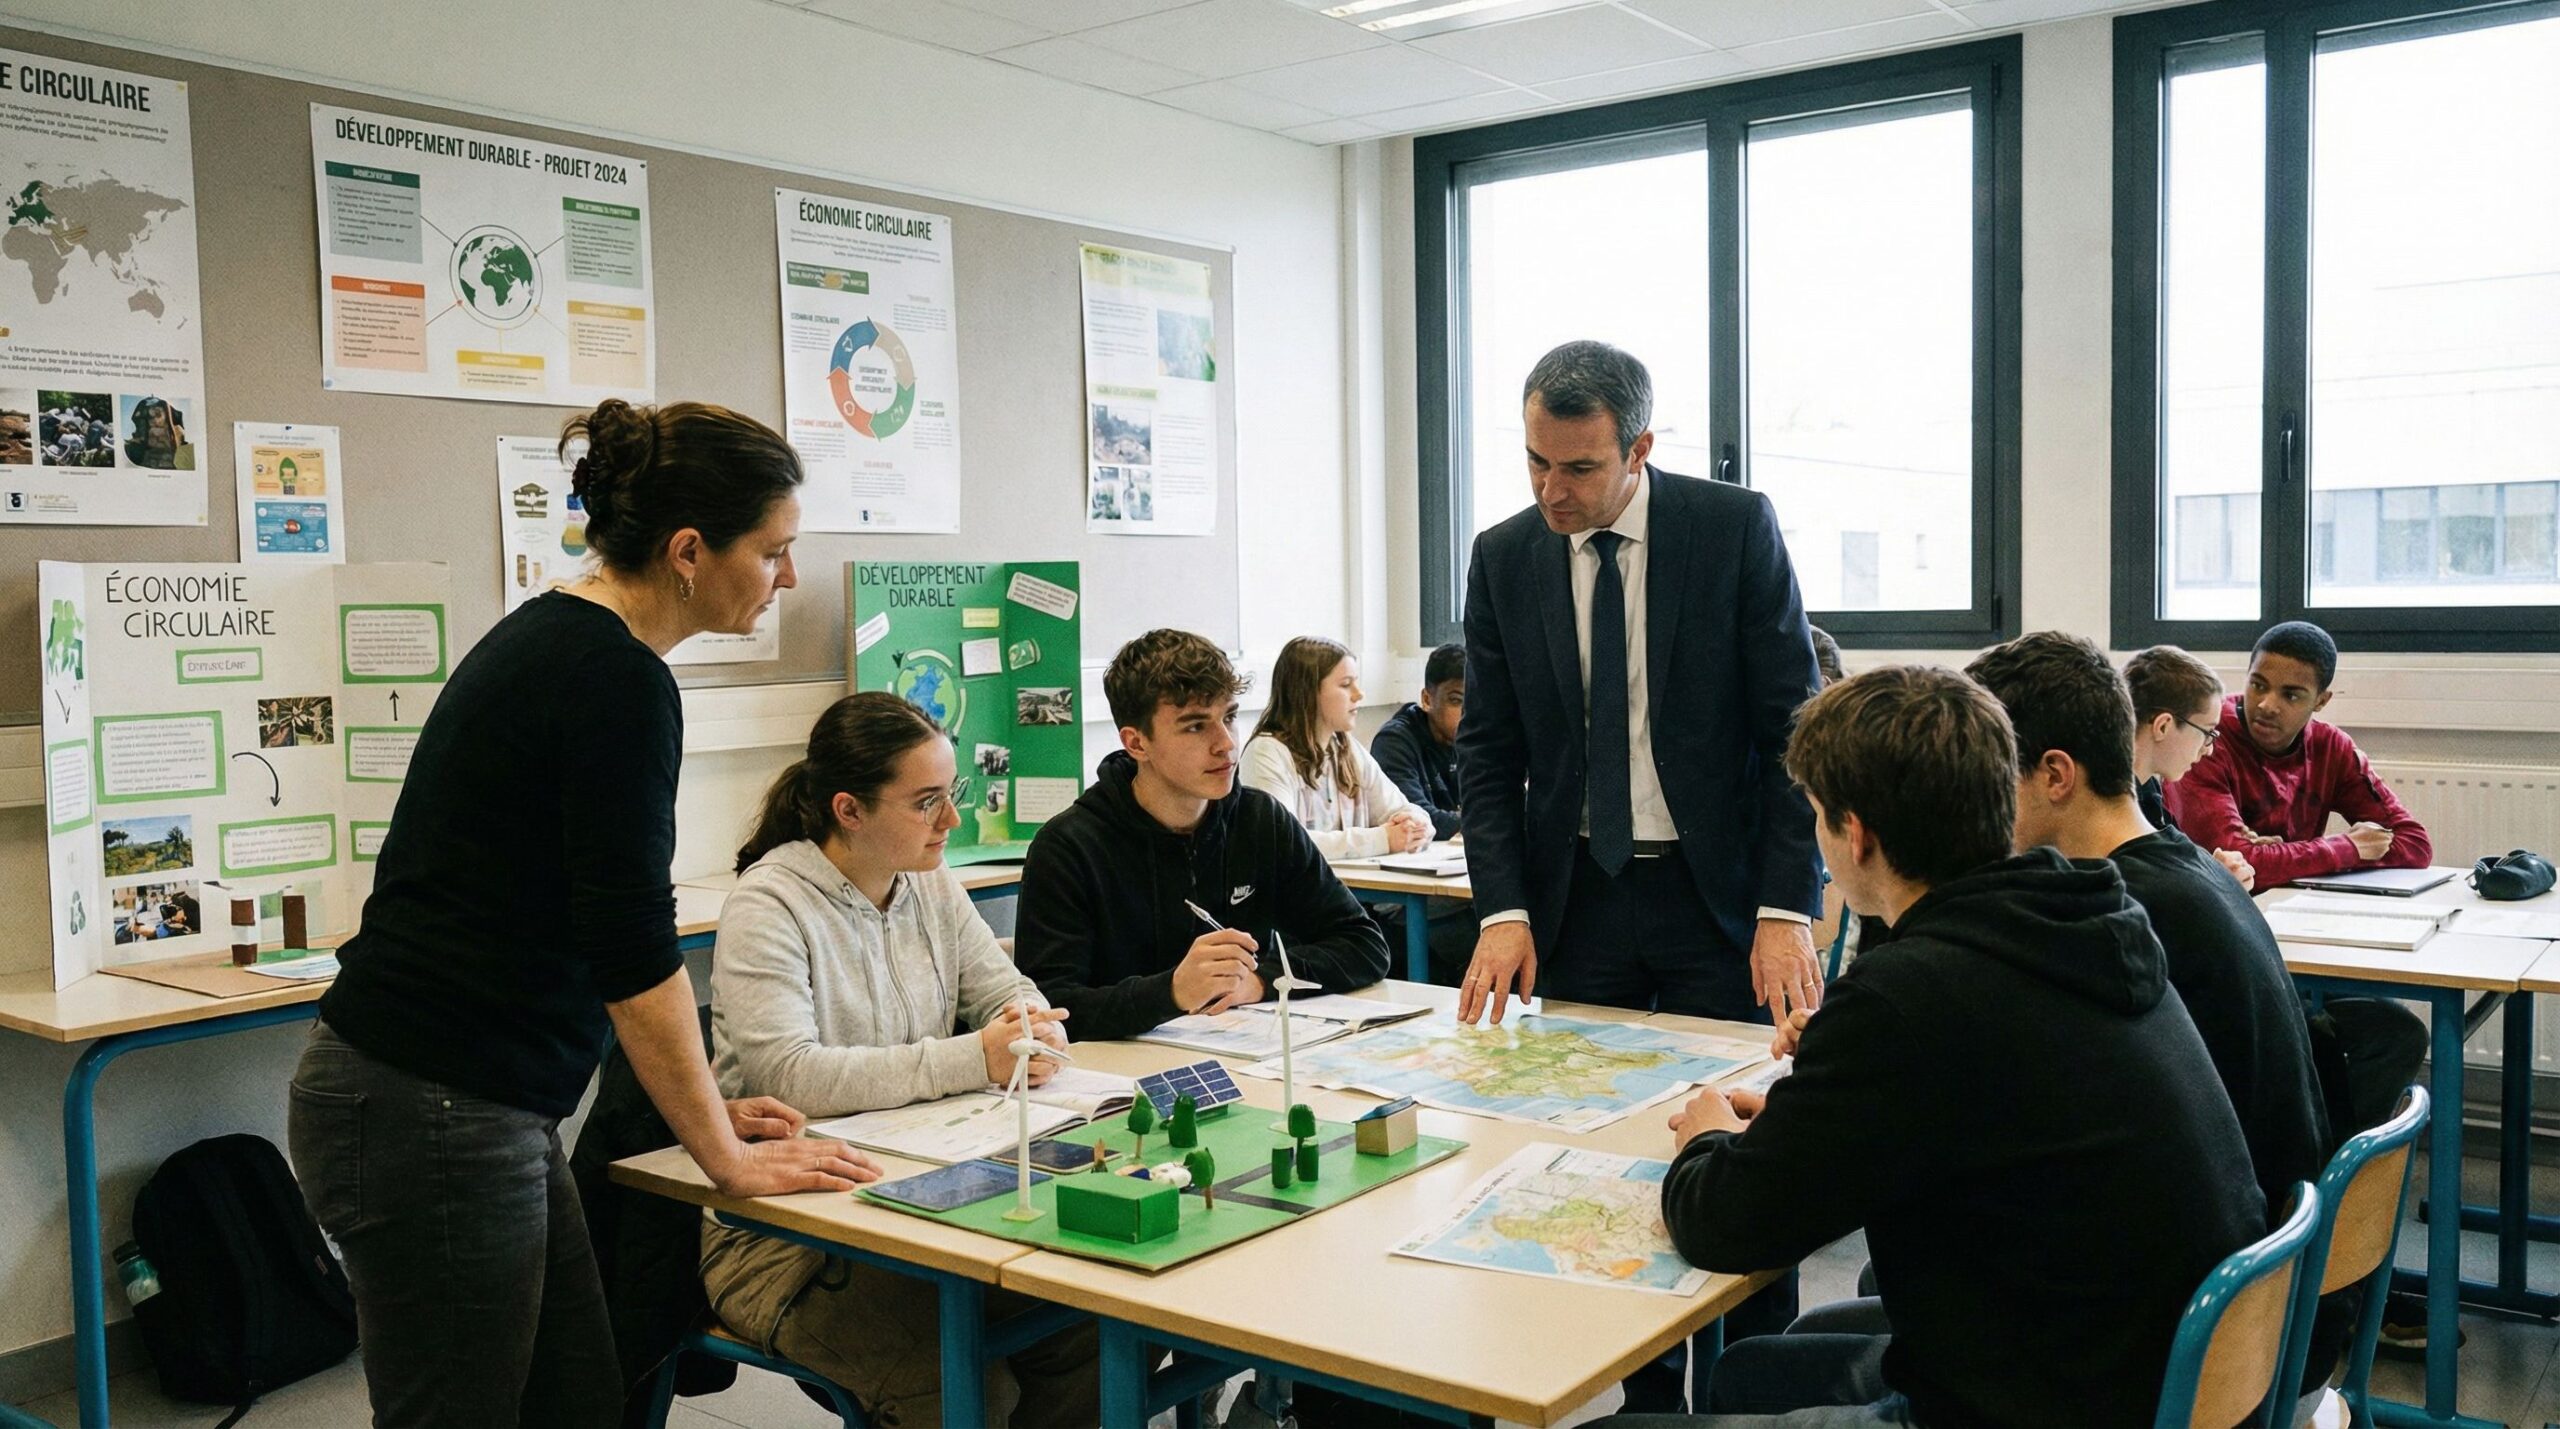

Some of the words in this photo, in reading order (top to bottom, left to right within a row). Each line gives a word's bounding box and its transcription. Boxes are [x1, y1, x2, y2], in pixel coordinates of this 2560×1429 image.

[20, 65, 151, 114] CIRCULAIRE
[335, 117, 465, 159] DÉVELOPPEMENT
[468, 141, 532, 169] DURABLE
[544, 153, 592, 180] PROJET
[594, 163, 627, 186] 2024
[799, 198, 862, 231] ÉCONOMIE
[865, 211, 933, 241] CIRCULAIRE
[106, 569, 248, 603] ÉCONOMIE
[860, 562, 986, 586] DÉVELOPPEMENT
[889, 587, 956, 608] DURABLE
[123, 606, 277, 639] CIRCULAIRE
